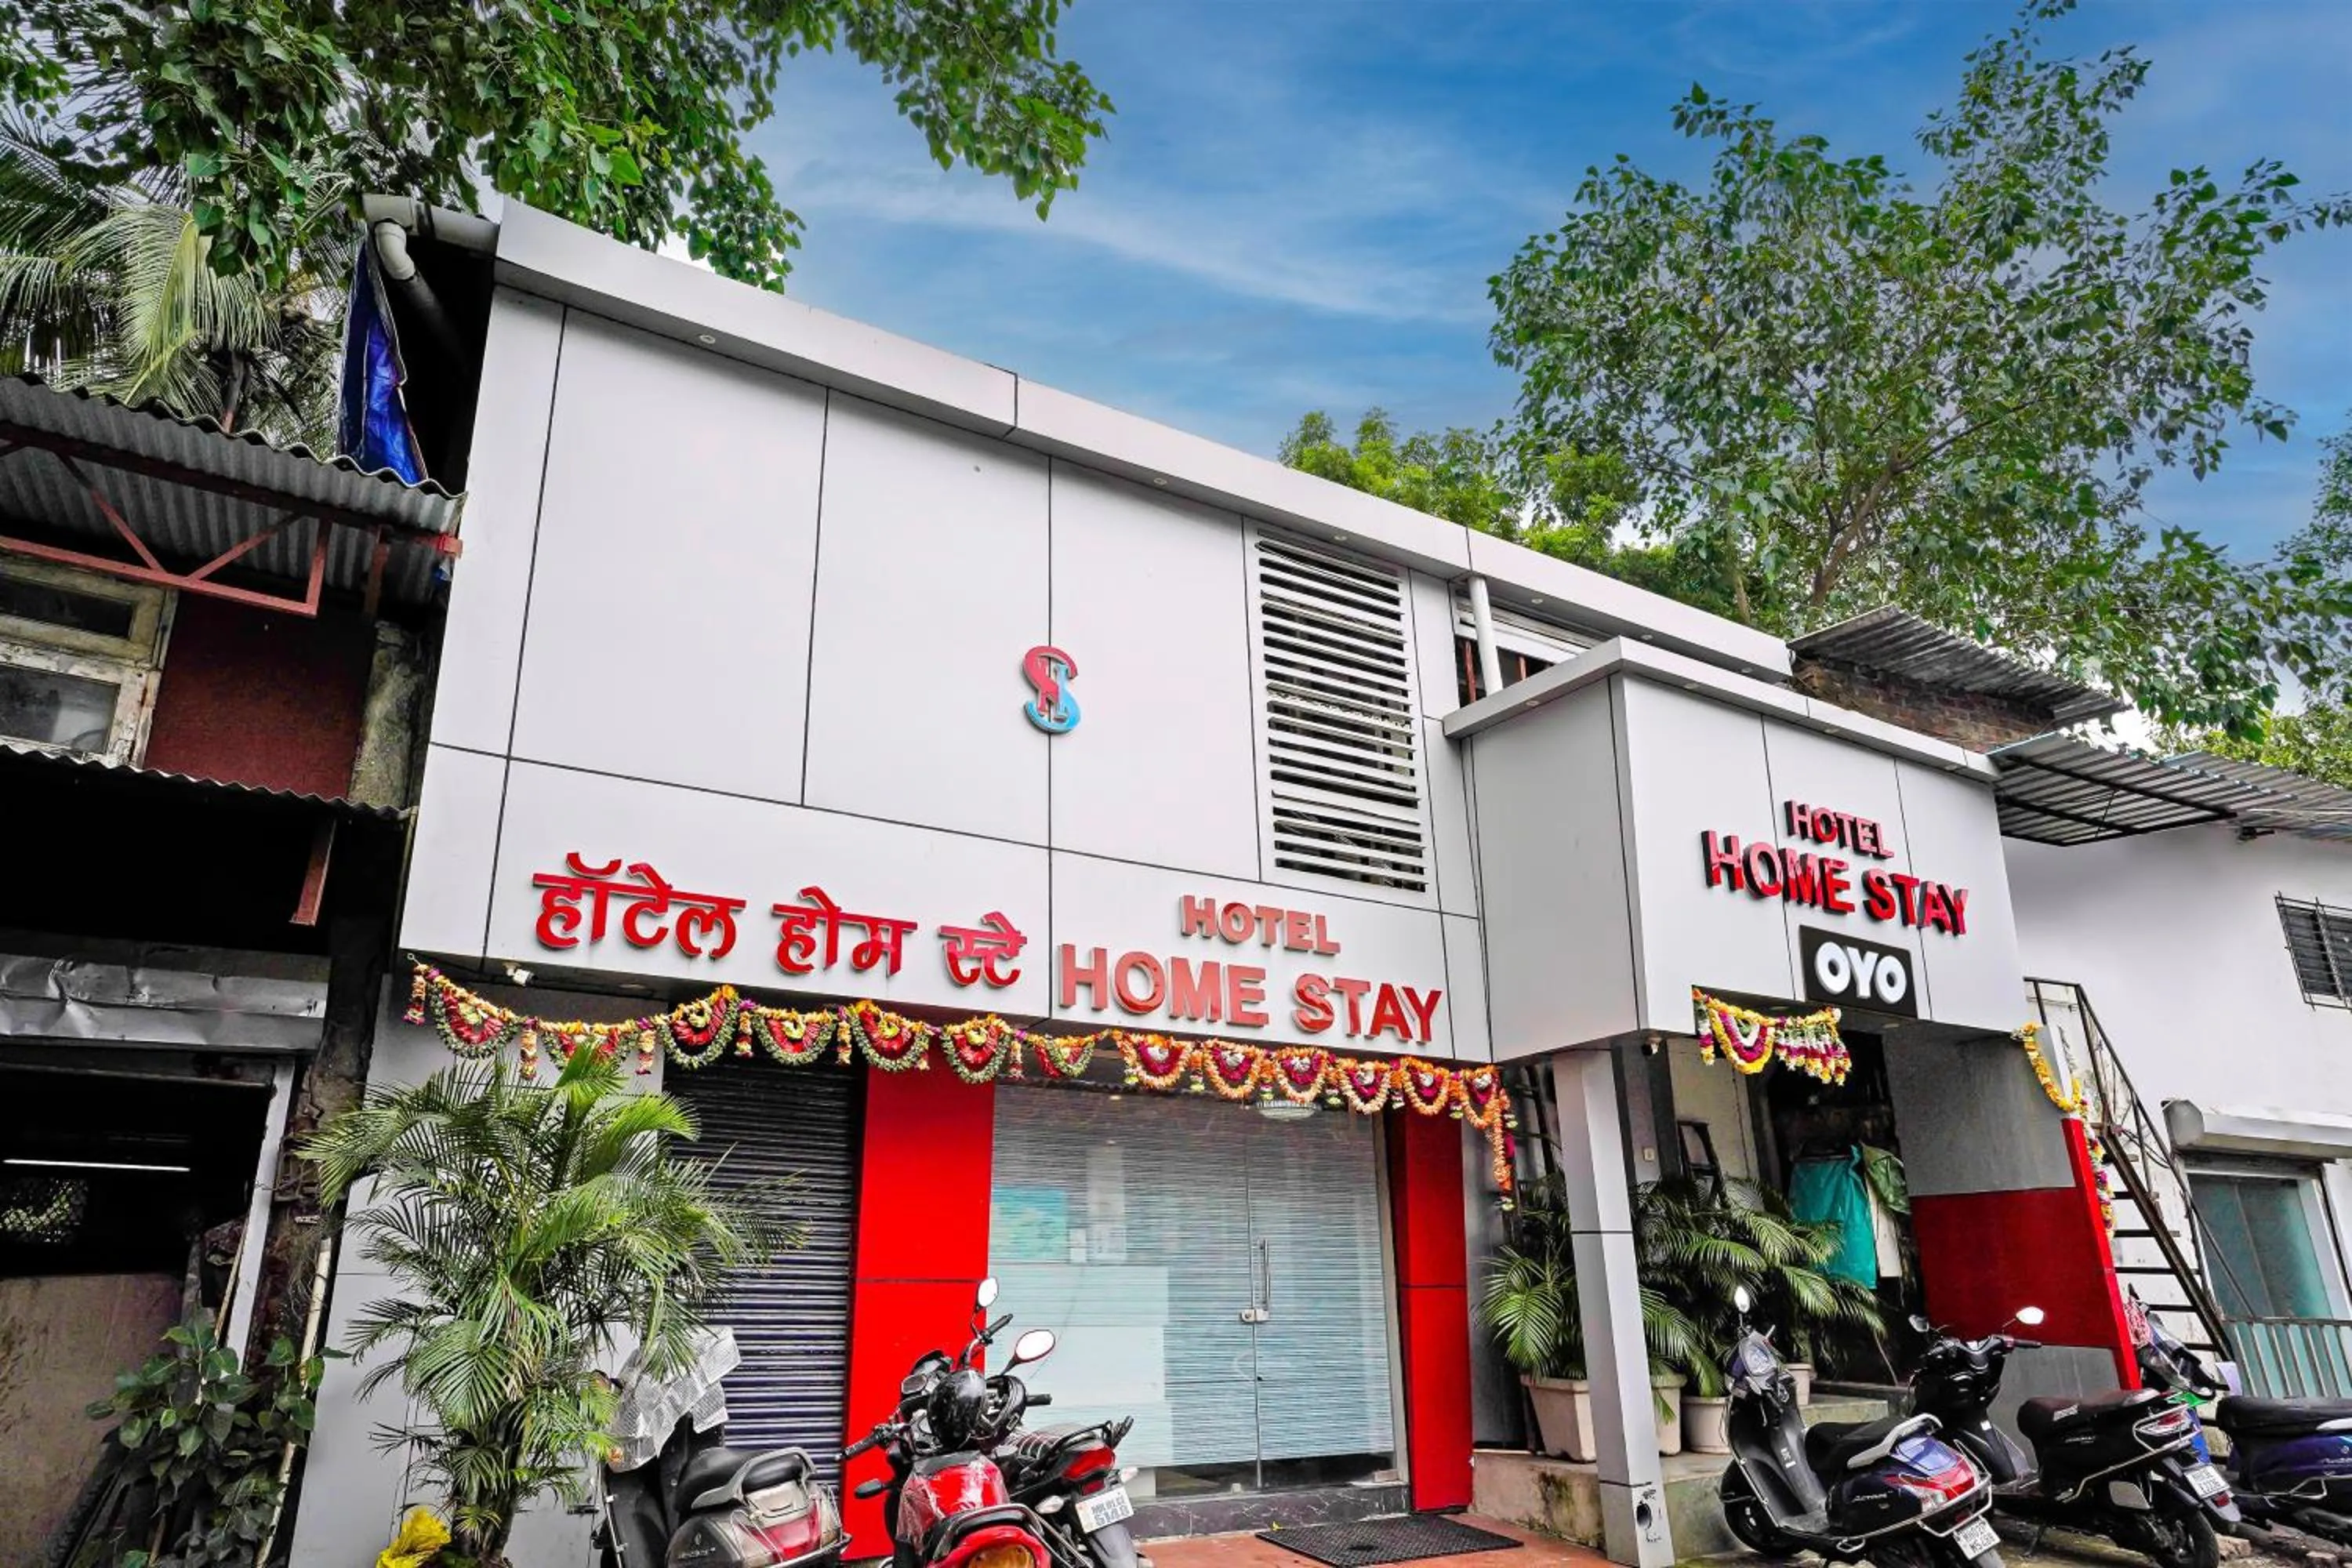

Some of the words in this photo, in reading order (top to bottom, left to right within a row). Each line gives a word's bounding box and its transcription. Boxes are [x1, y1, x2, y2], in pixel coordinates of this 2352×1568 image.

[1784, 800, 1894, 859] HOTEL
[533, 852, 746, 958] हॉटेल
[773, 885, 917, 976] होम
[940, 911, 1028, 987] स्टे
[1700, 829, 1856, 913] HOME
[1862, 868, 1969, 935] STAY
[1180, 895, 1341, 955] HOTEL
[1058, 943, 1269, 1027] HOME
[1292, 972, 1443, 1044] STAY
[1814, 941, 1907, 1004] OYO
